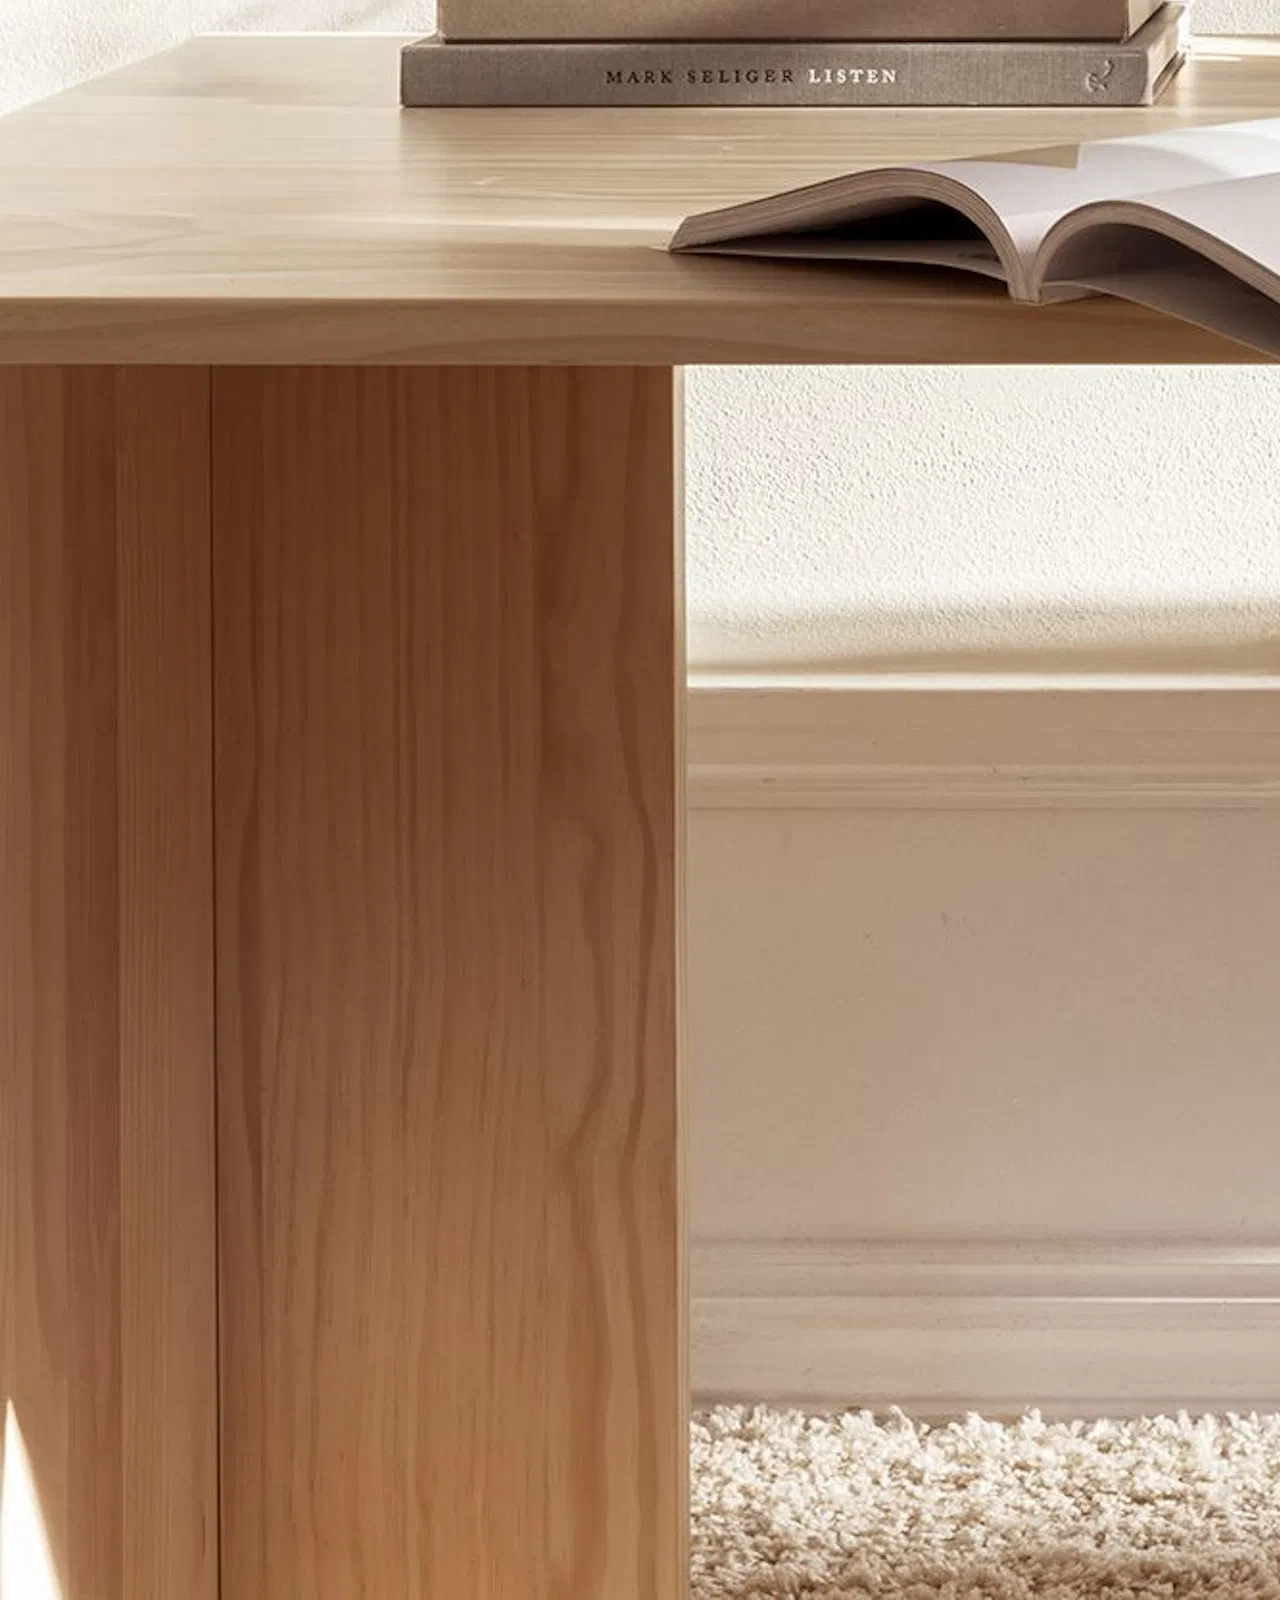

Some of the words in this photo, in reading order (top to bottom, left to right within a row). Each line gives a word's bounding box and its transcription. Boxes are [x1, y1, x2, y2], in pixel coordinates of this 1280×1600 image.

[605, 69, 674, 84] MARK
[686, 69, 796, 84] SELIGER
[807, 68, 898, 85] LISTEN
